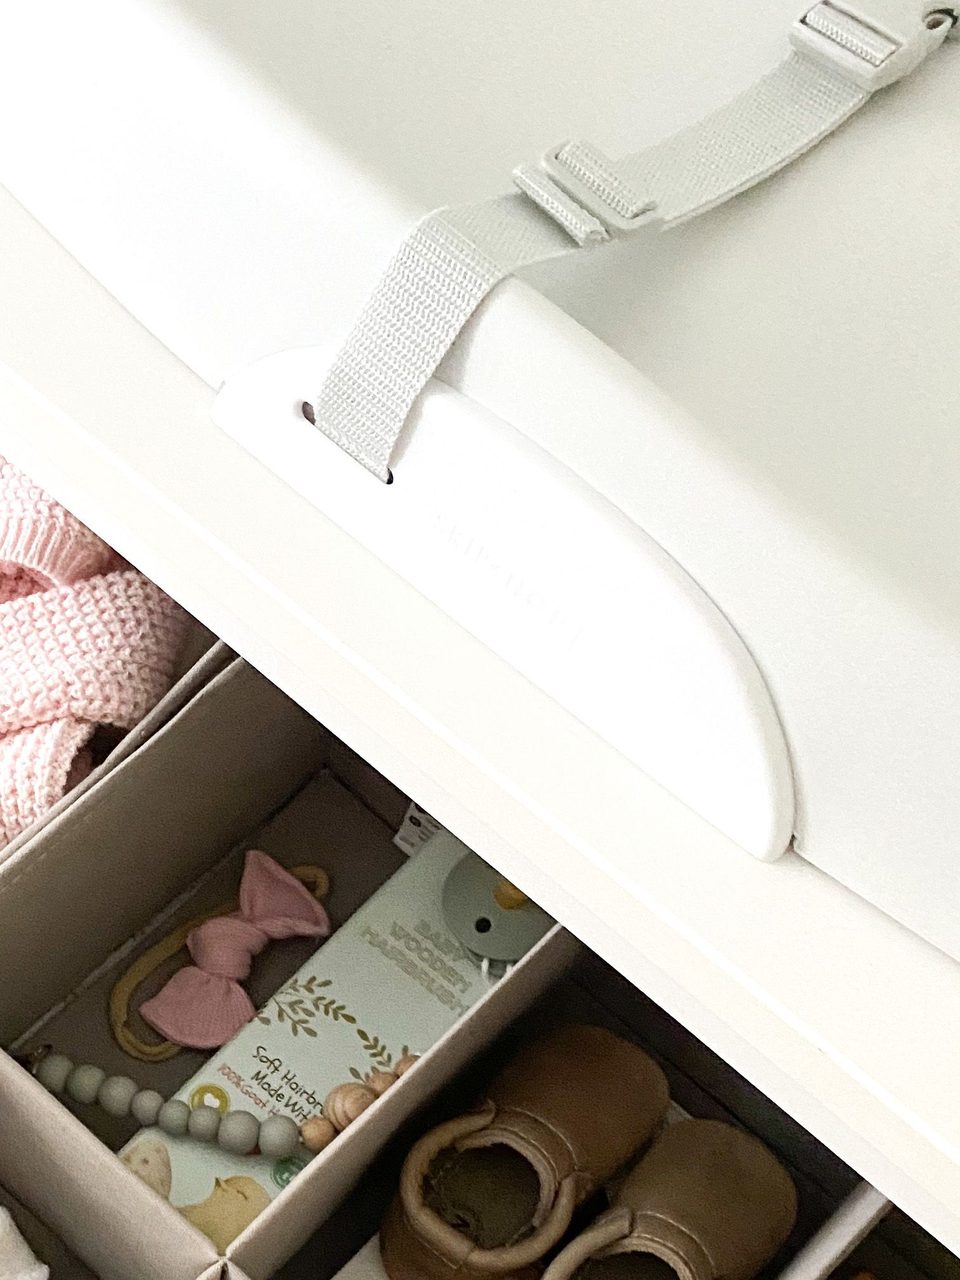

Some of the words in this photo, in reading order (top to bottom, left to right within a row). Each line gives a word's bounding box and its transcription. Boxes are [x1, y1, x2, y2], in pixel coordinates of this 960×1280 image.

[251, 1070, 285, 1103] Made
[284, 1096, 312, 1123] Wit
[252, 1045, 282, 1075] Soft
[281, 1069, 324, 1114] Hairbr
